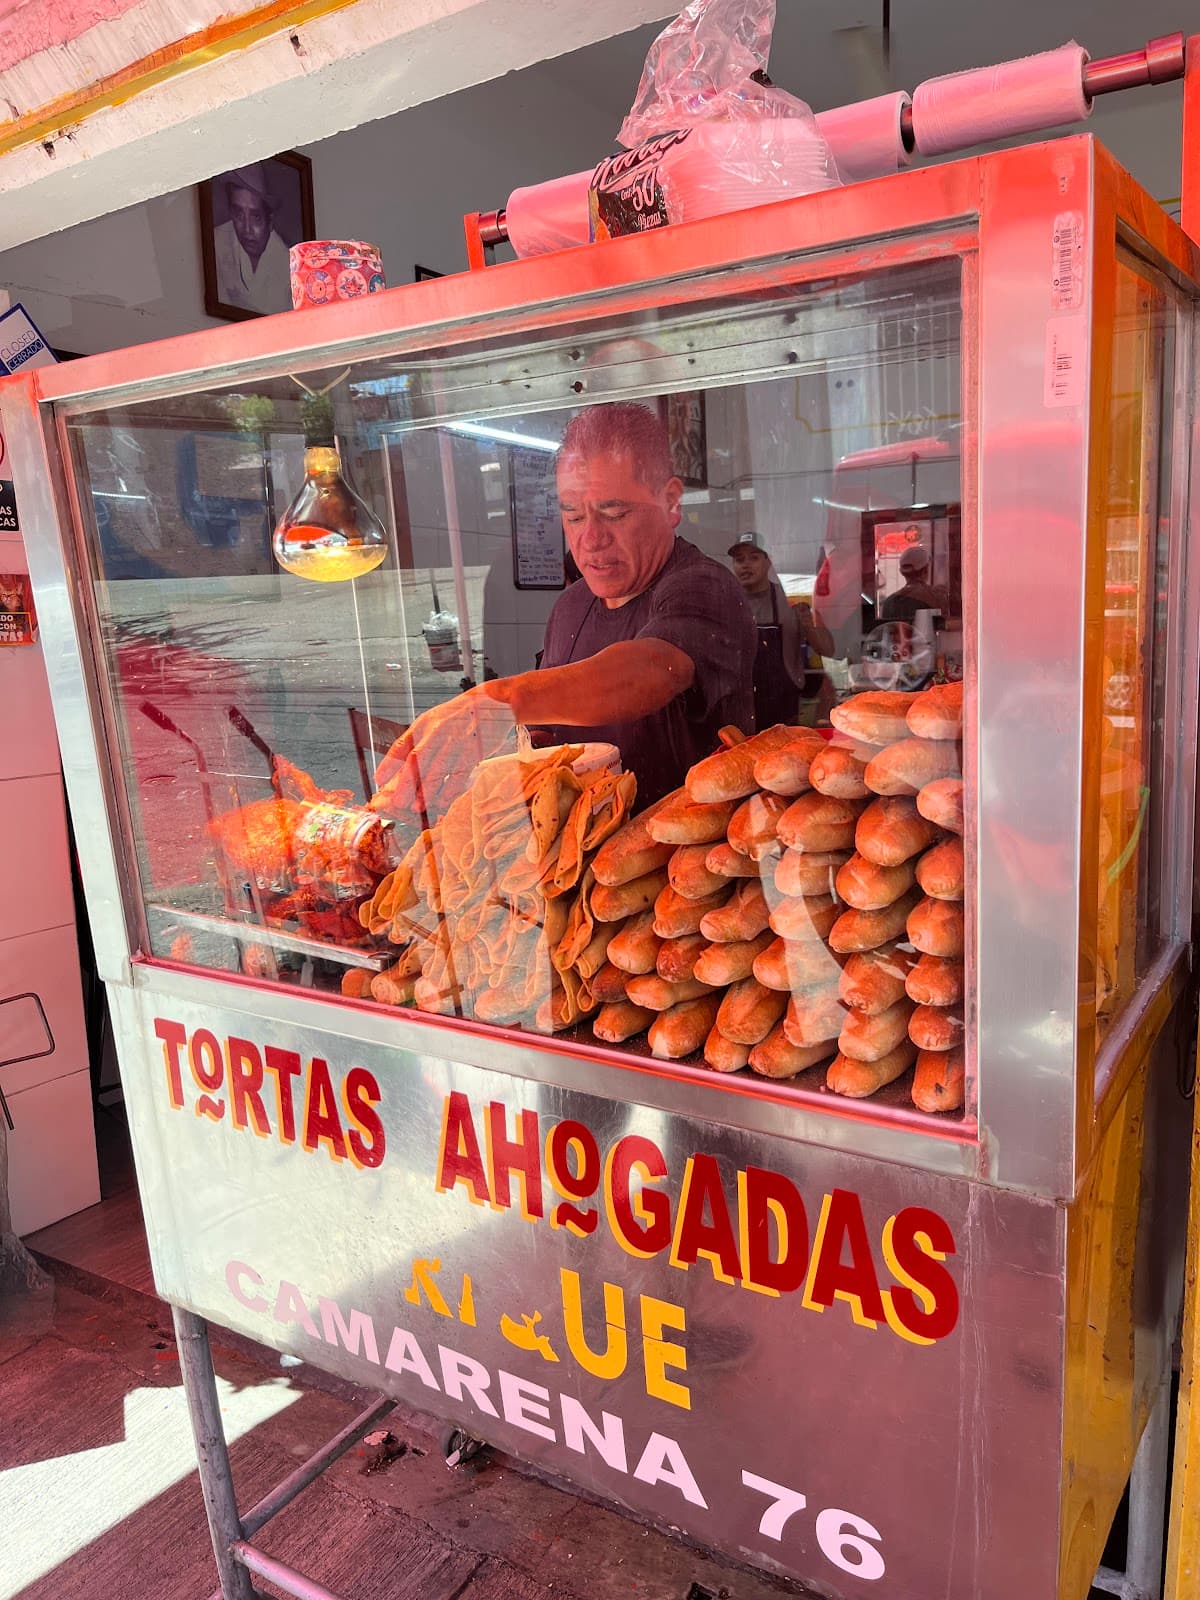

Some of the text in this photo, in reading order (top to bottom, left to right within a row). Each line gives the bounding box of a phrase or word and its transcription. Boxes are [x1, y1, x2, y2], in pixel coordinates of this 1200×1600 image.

[632, 167, 657, 211] 50
[1, 330, 36, 360] CLOSED
[7, 340, 43, 370] CERRADO
[0, 614, 14, 622] DO
[154, 1017, 960, 1346] TORTAS AHOGADAS
[225, 1260, 886, 1580] CAMARENA 76
